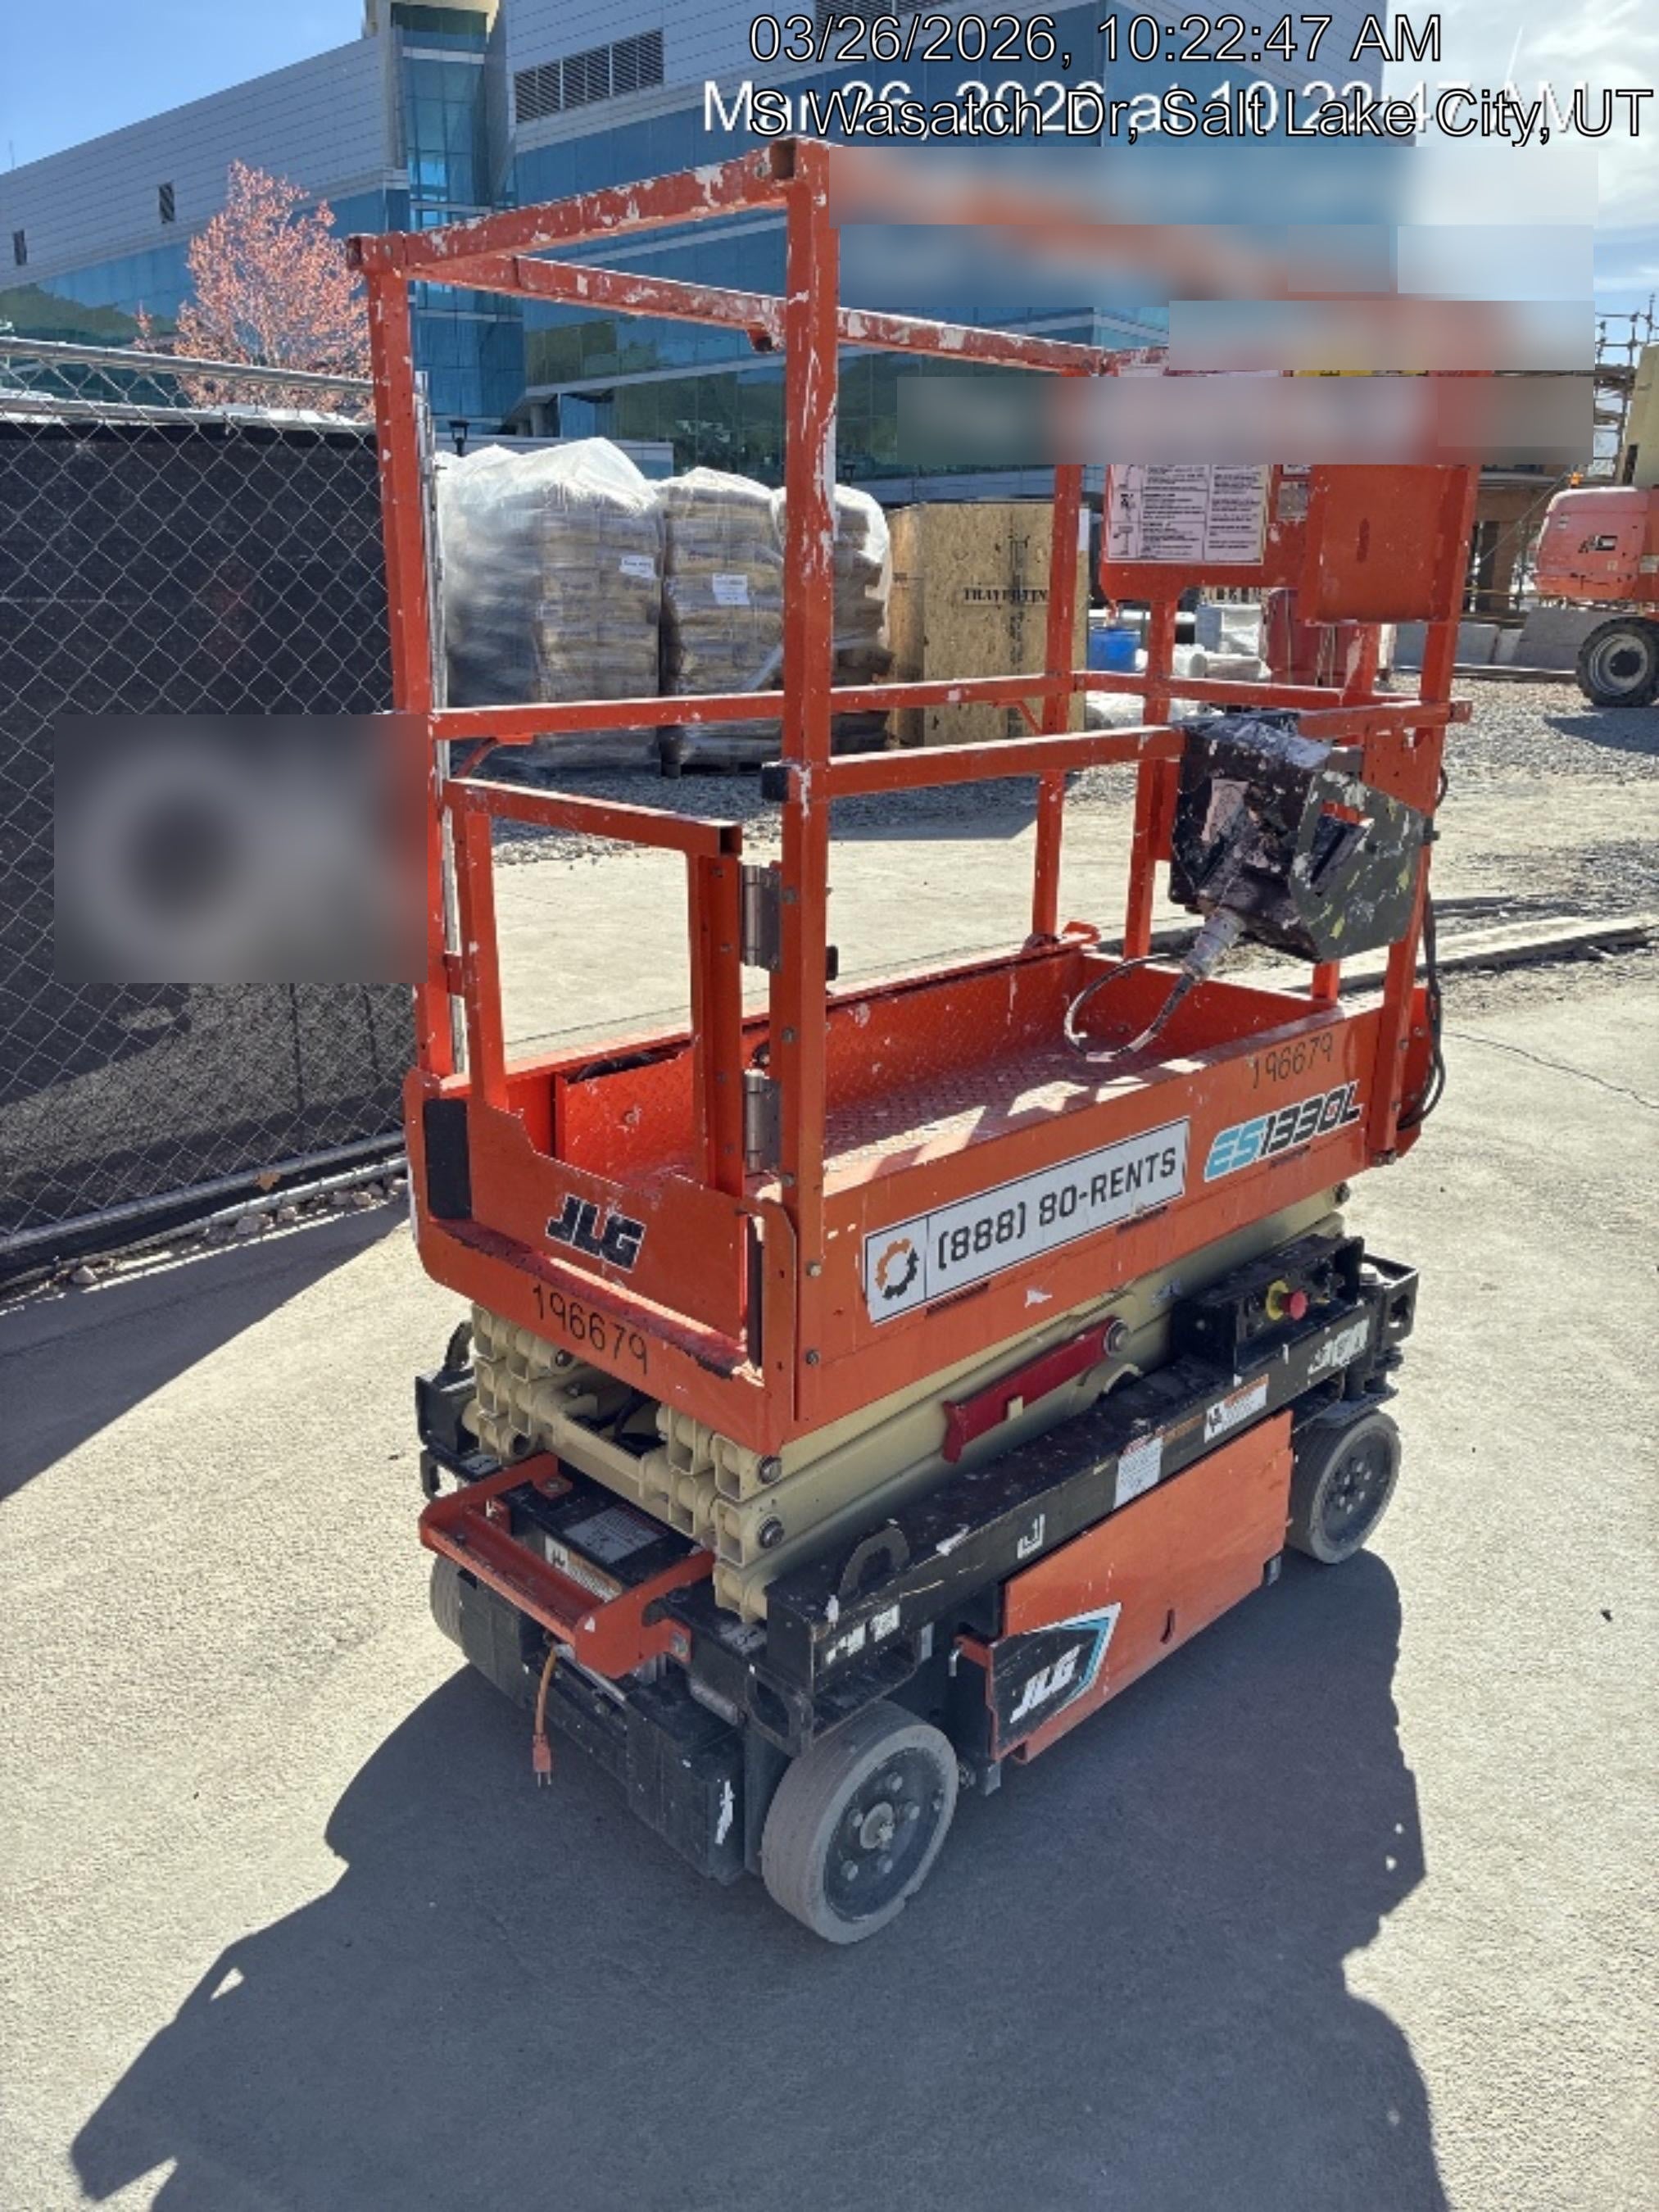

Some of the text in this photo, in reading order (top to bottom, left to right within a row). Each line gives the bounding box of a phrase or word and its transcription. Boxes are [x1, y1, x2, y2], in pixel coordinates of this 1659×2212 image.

[1252, 1031, 1334, 1090] 196679
[1204, 1080, 1364, 1181] ES1330L
[546, 1192, 646, 1273] JLG
[938, 1146, 1176, 1270] (888) 80-RENTS
[533, 1284, 647, 1375] 196679
[1009, 1643, 1082, 1724] JLG
